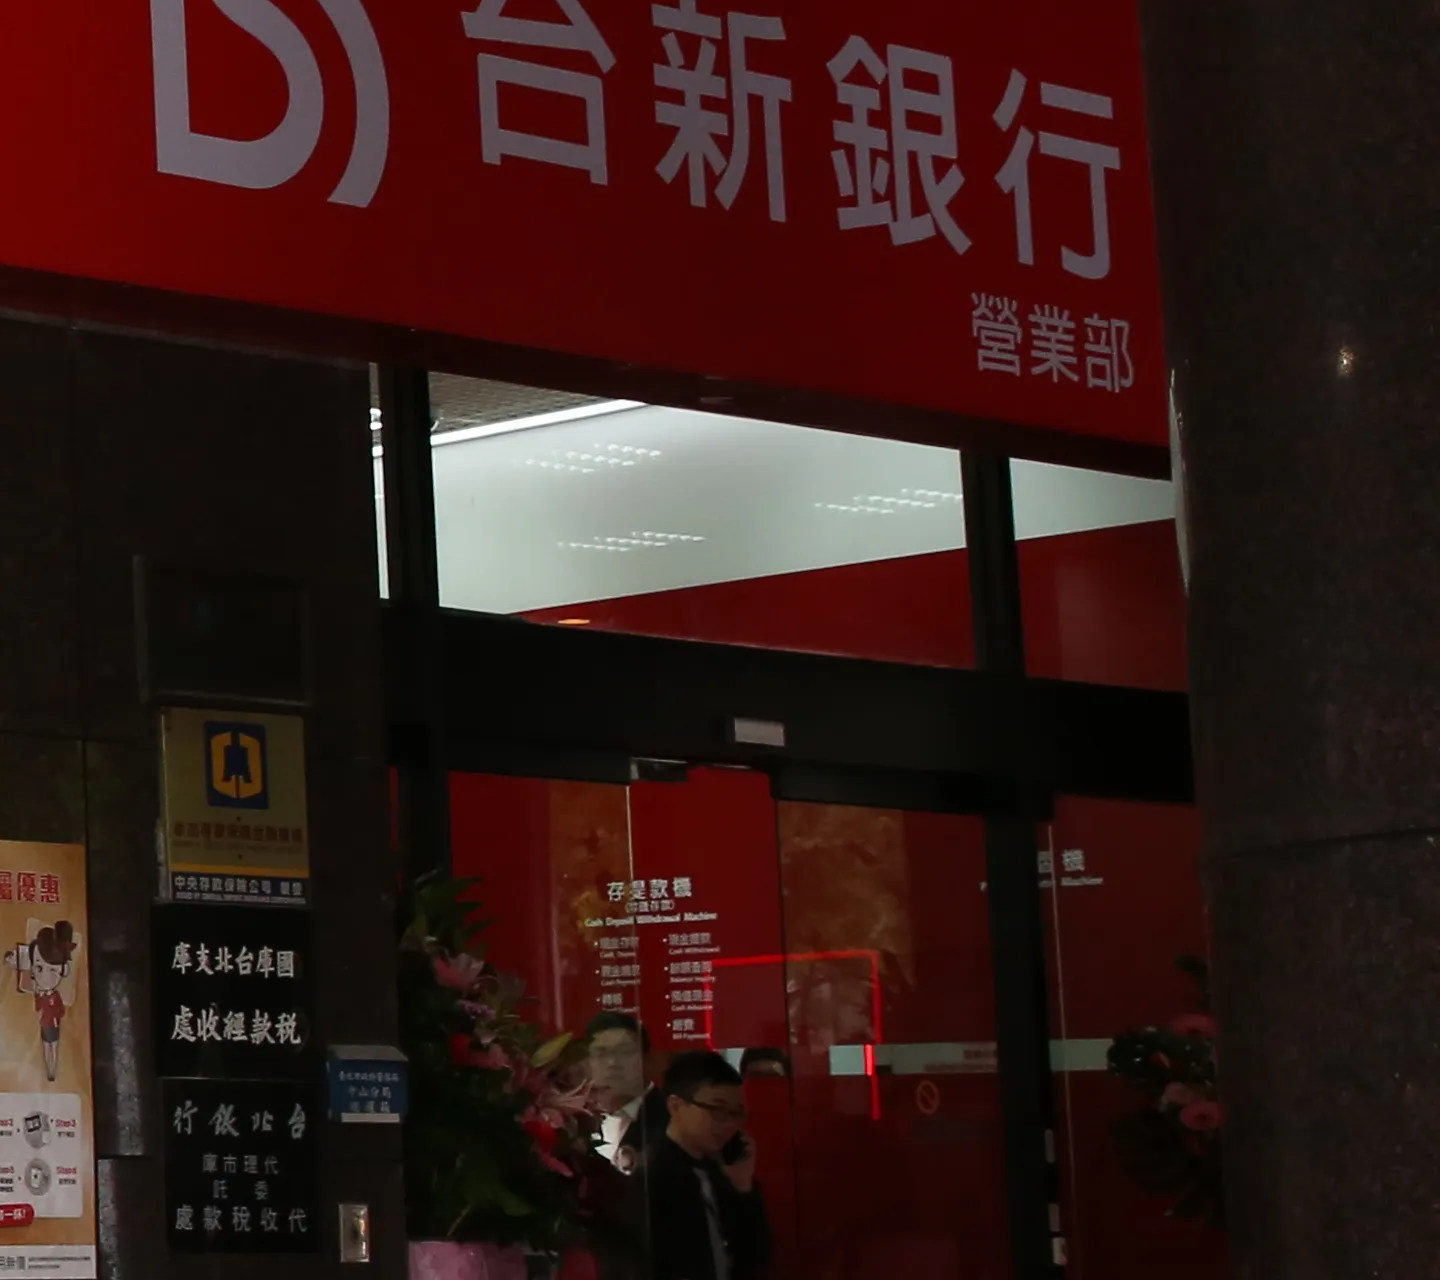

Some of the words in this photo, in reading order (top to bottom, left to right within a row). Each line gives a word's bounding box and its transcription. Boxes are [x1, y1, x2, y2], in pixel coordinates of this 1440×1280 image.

[970, 291, 1136, 395] 營業部
[606, 876, 693, 903] 存提款機
